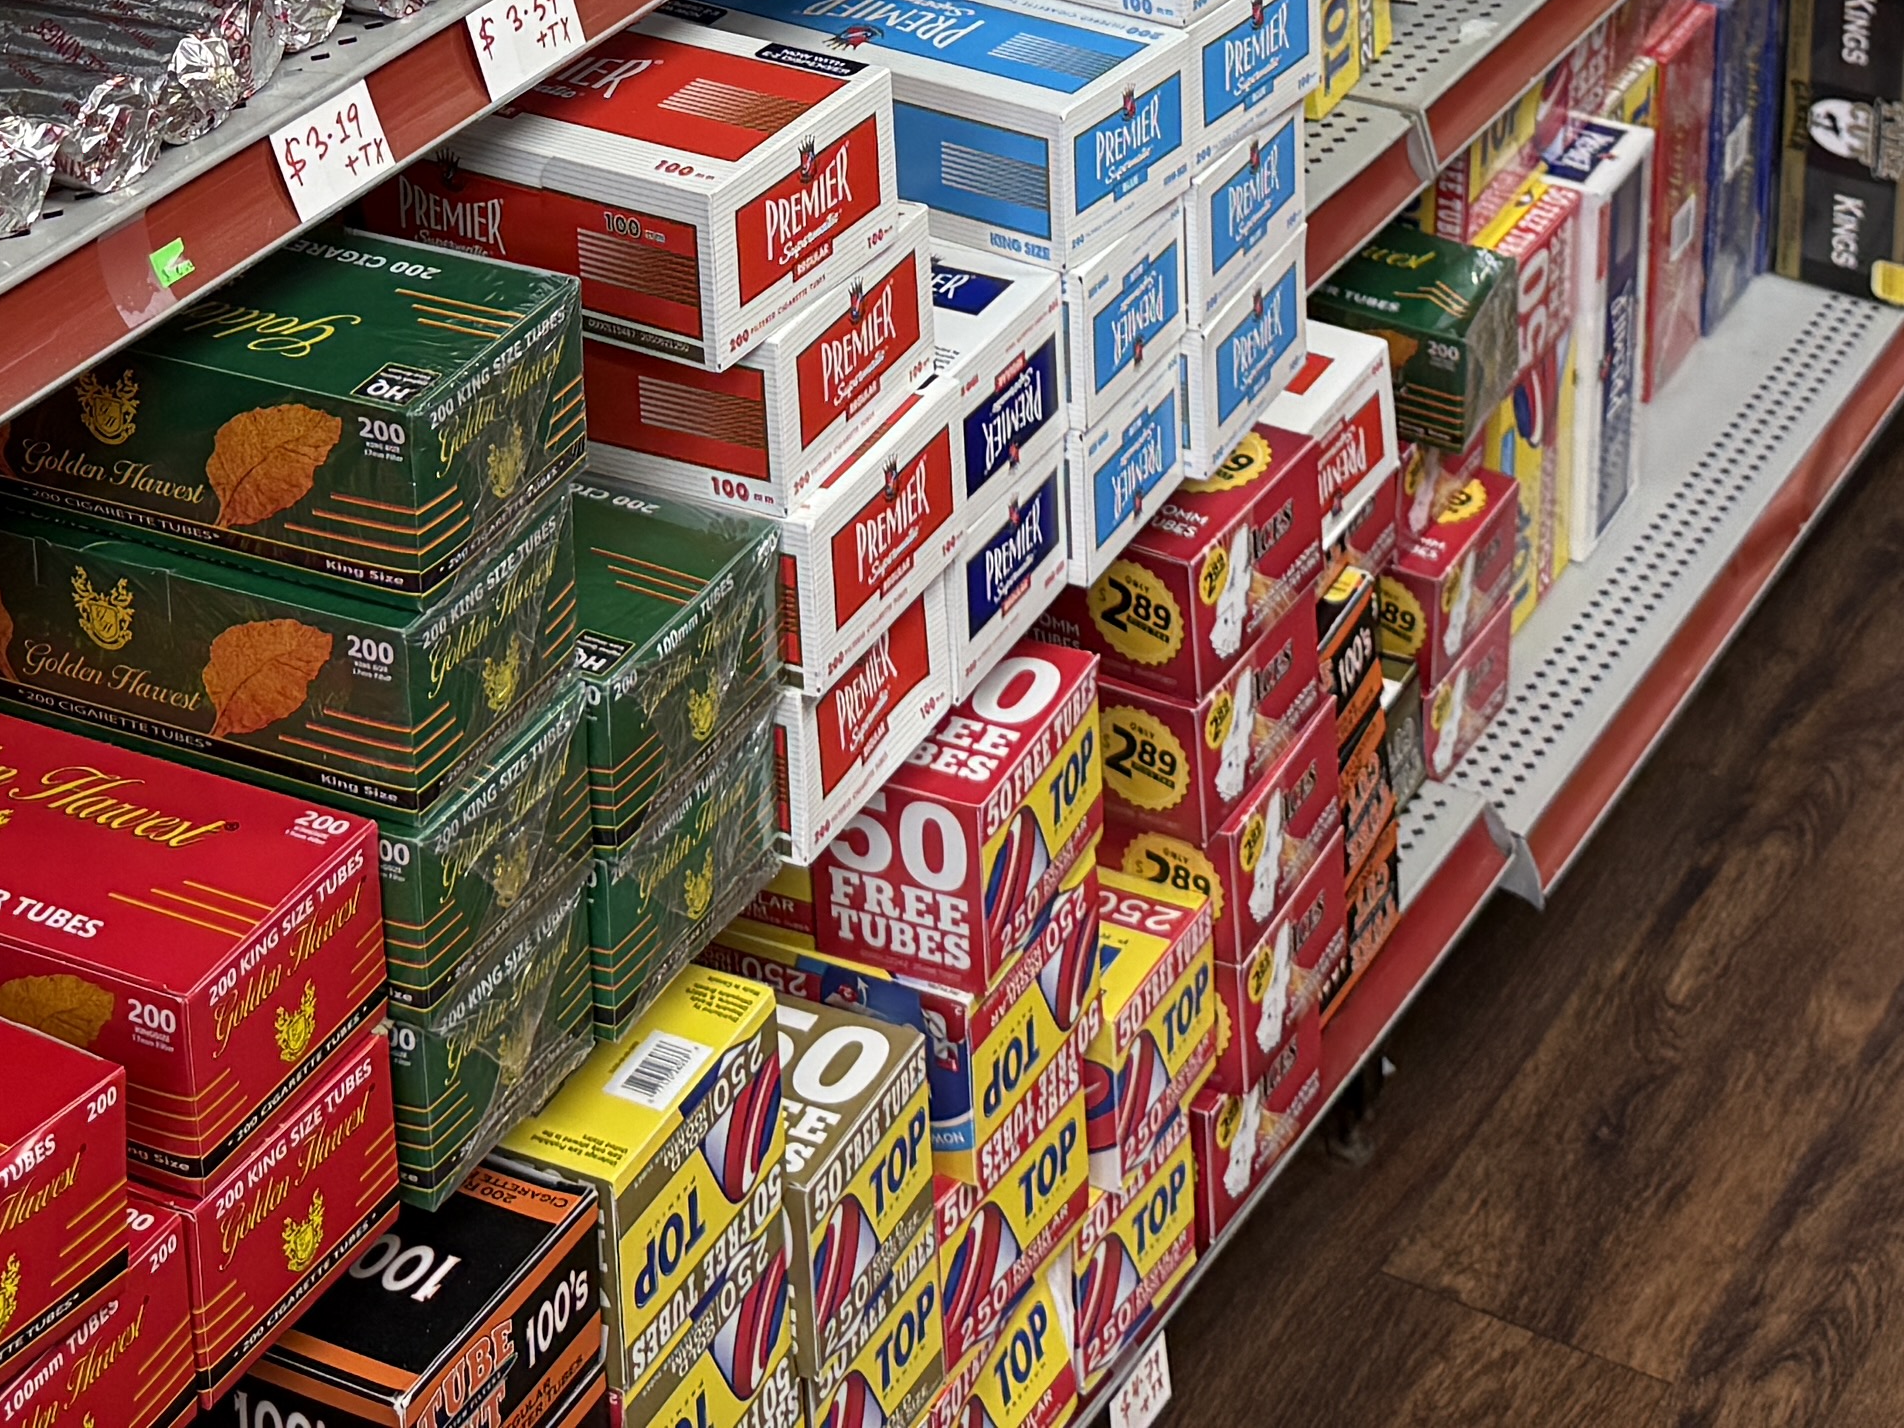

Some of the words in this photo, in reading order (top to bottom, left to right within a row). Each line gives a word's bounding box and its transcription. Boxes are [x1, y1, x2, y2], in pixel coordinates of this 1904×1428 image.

[281, 100, 366, 186] $3.19
[603, 211, 642, 235] 100
[763, 151, 851, 258] PREMIER
[357, 417, 405, 448] 200
[21, 438, 108, 485] Golden
[110, 460, 206, 505] Harvest
[855, 479, 931, 563] PREMIER
[325, 557, 361, 582] King
[366, 566, 404, 586] Size
[33, 762, 222, 849] Harvest
[1047, 729, 1095, 823] TOP
[827, 802, 967, 896] 50
[11, 890, 105, 941] TUBES
[827, 870, 967, 931] FREE
[830, 901, 971, 972] TUBES
[126, 997, 178, 1036] 200
[870, 1102, 928, 1199] TOP
[524, 1261, 591, 1360] 100's
